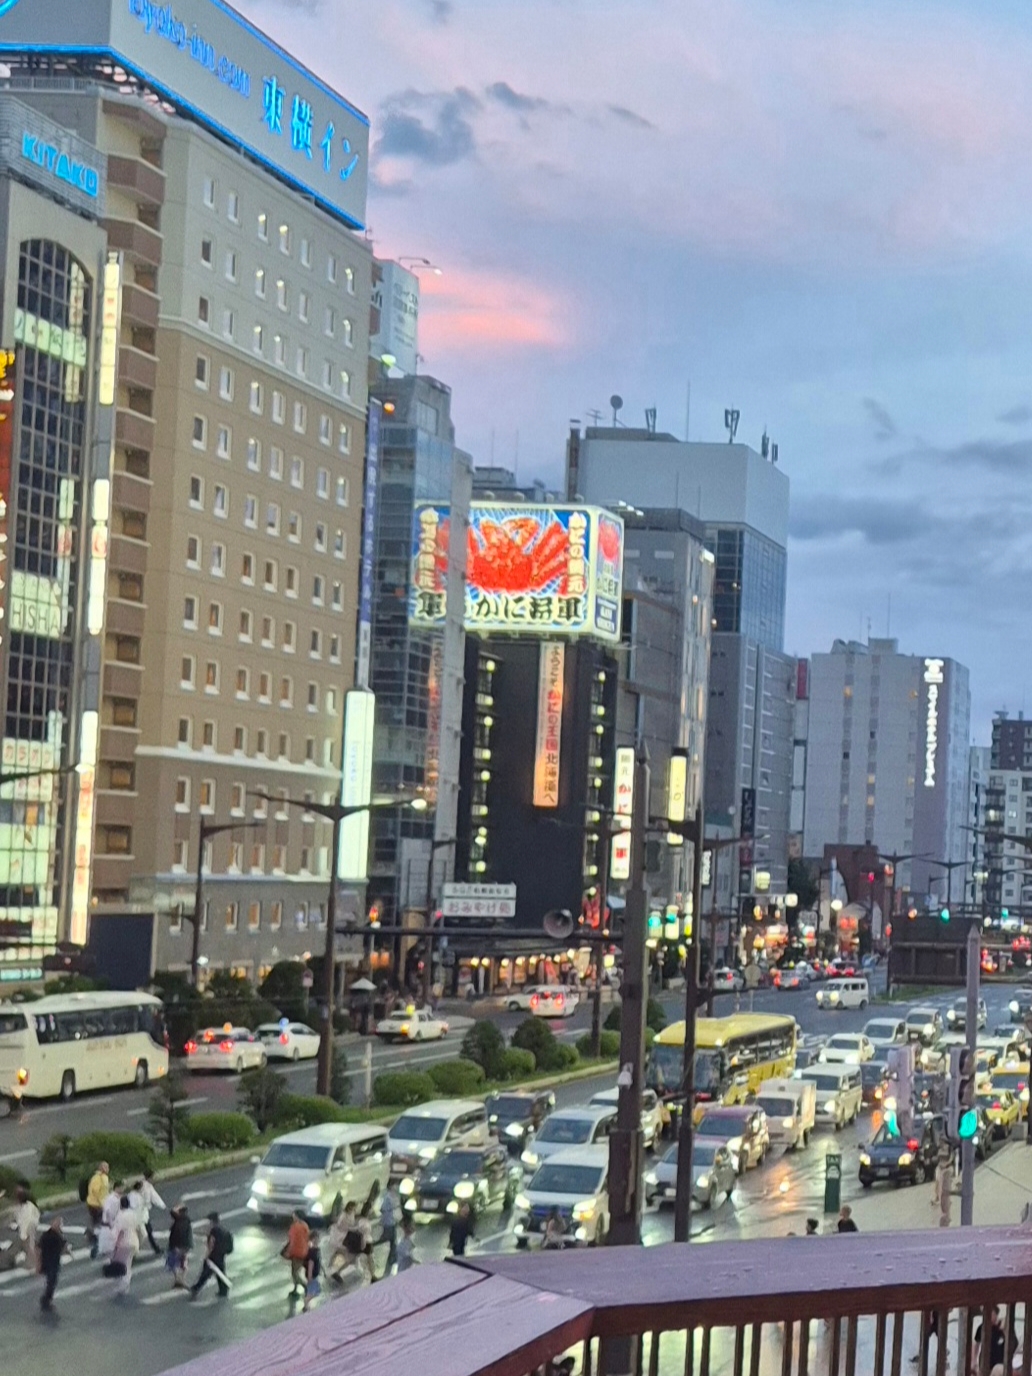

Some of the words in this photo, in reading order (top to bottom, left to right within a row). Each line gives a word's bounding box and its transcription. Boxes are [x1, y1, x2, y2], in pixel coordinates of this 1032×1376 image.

[262, 76, 358, 181] 東横イン
[476, 595, 582, 621] かに将軍
